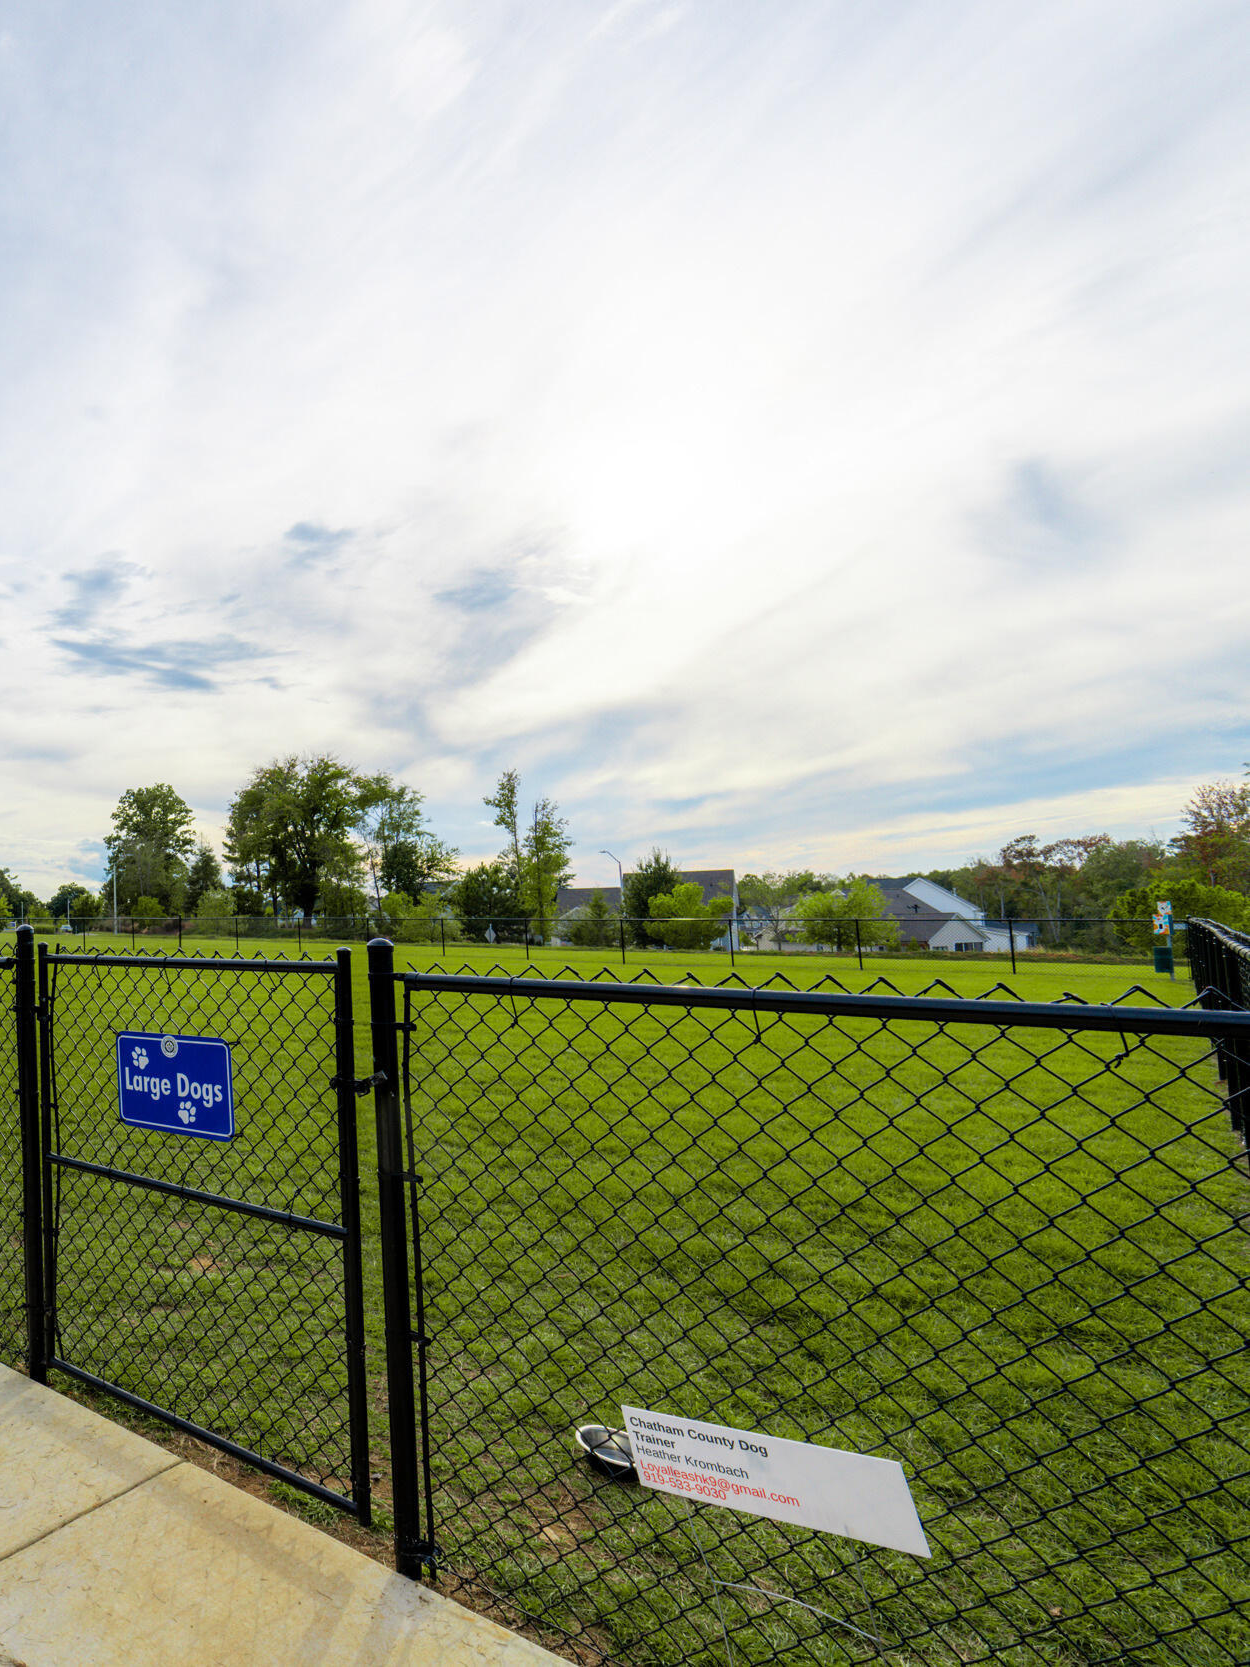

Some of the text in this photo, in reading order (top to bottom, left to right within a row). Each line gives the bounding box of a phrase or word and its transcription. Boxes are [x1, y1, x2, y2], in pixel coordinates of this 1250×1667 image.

[125, 1066, 223, 1108] Large Dogs
[629, 1416, 768, 1458] Chatham County Dog
[632, 1430, 676, 1449] Trainer
[635, 1444, 749, 1480] Heather Krombach
[640, 1459, 800, 1507] Loyalleashk9@gmail.com
[643, 1470, 727, 1500] 919-533-9030
